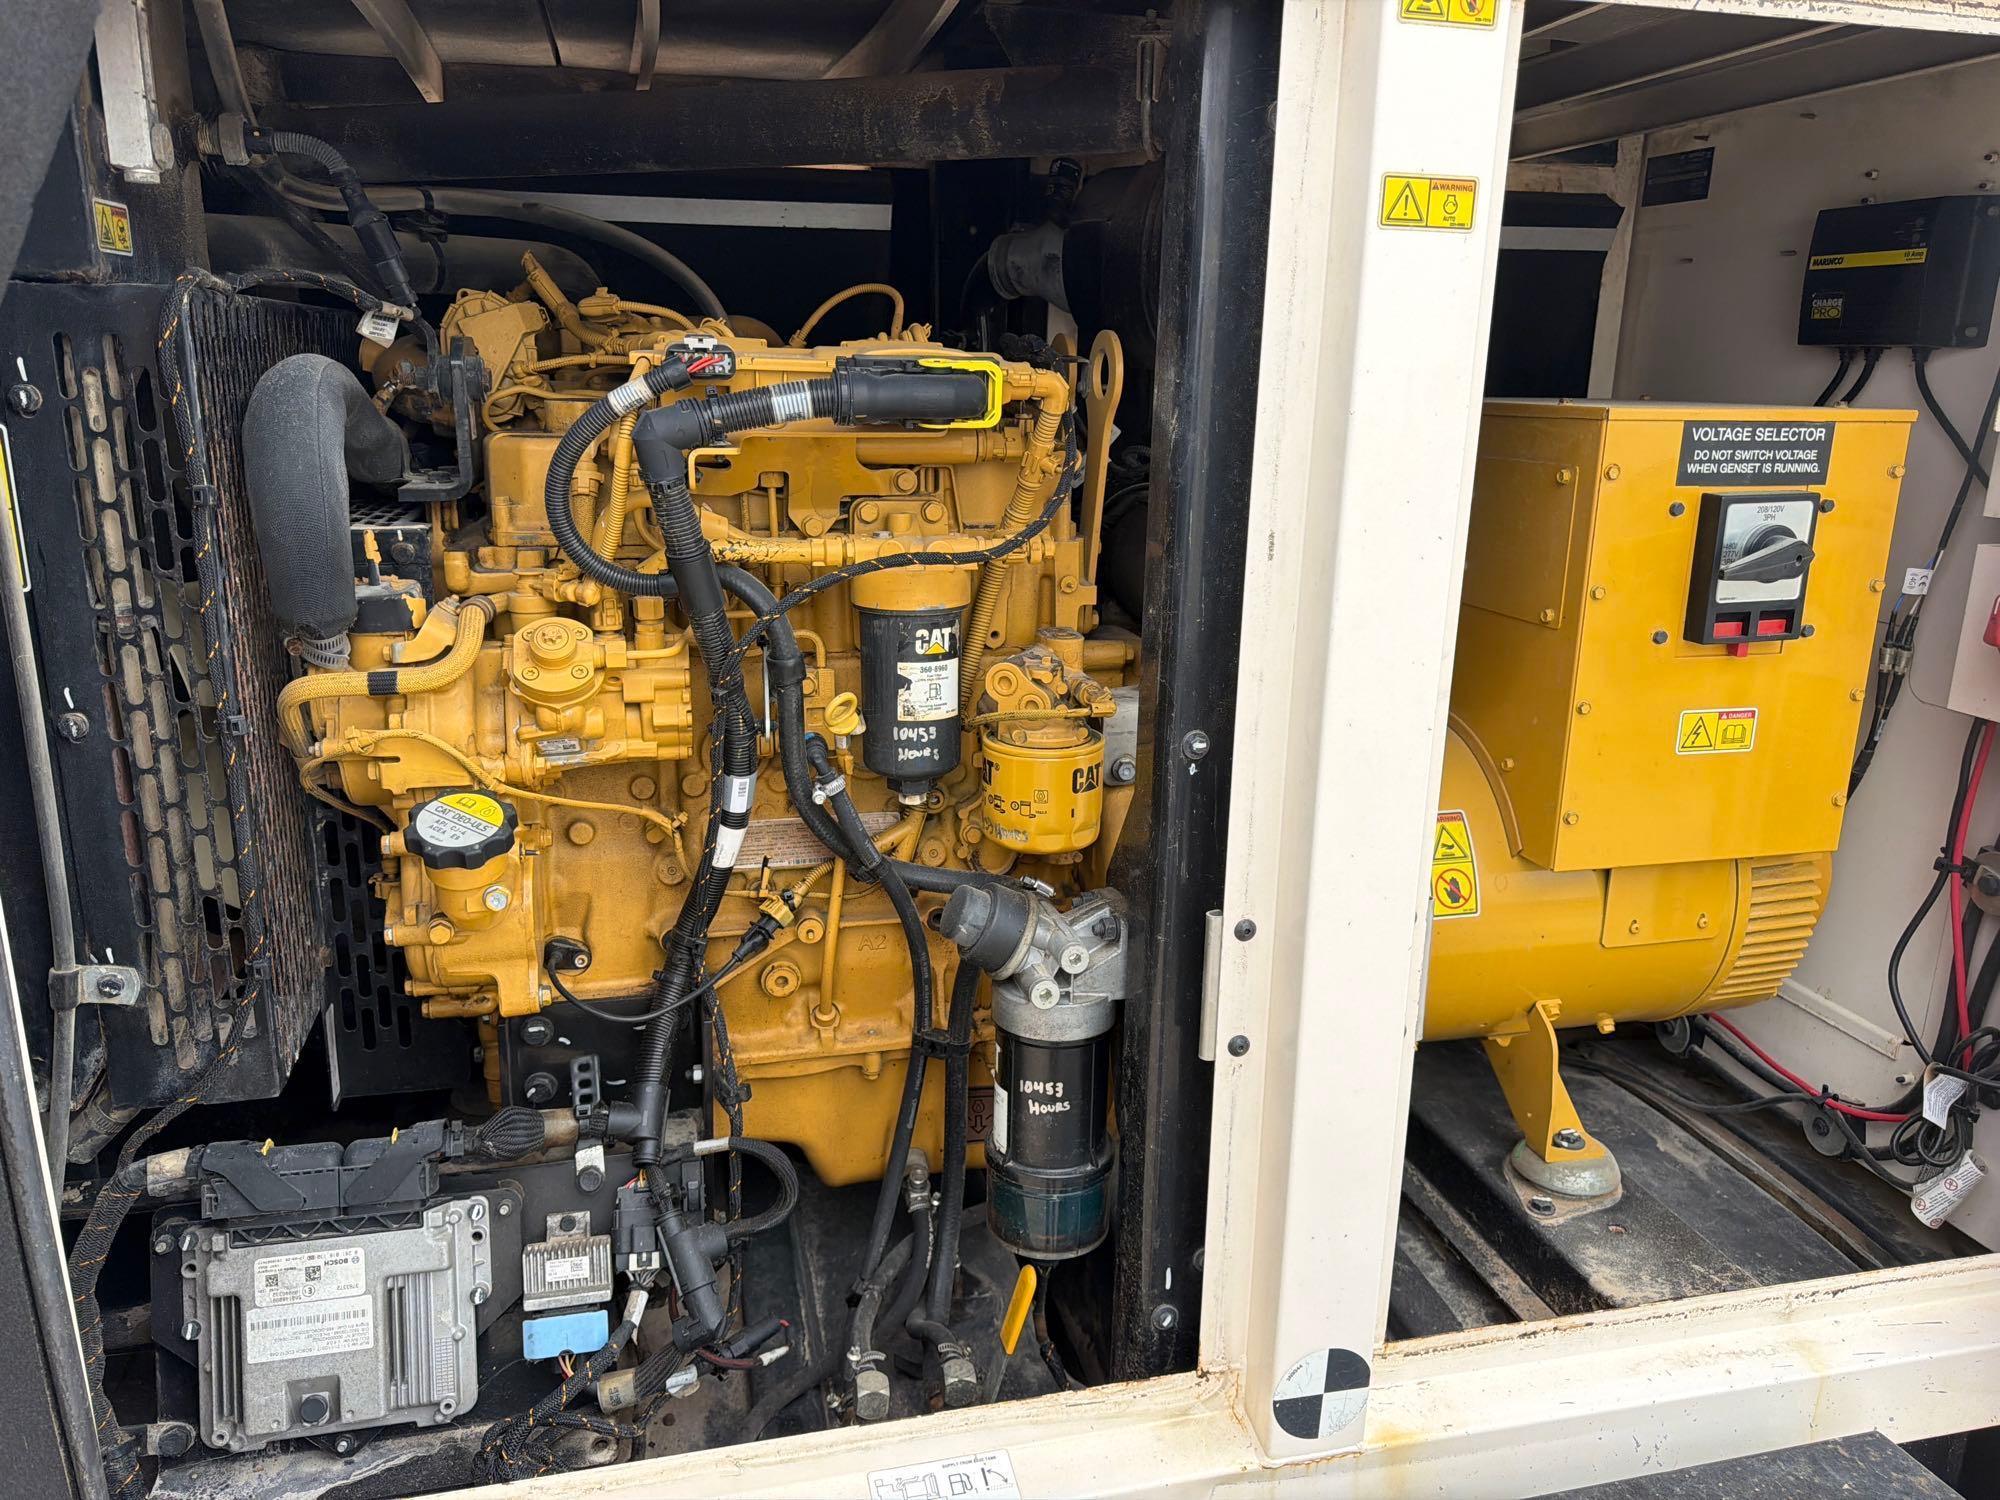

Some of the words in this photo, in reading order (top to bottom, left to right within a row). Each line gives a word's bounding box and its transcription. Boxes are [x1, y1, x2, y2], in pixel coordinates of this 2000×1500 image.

[1440, 184, 1473, 192] WARNING
[1812, 256, 1844, 266] MARINCO
[1812, 298, 1843, 307] CHARGE
[1812, 307, 1840, 318] PRO
[1692, 428, 1752, 442] VOLTAGE
[1755, 428, 1825, 442] SELECTOR
[1694, 450, 1709, 460] DO
[1712, 450, 1732, 460] NOT
[1734, 450, 1773, 460] SWITCH
[1775, 450, 1818, 460] VOLTAGE
[1687, 463, 1717, 473] WHEN
[1720, 463, 1760, 473] GENSET
[1762, 463, 1772, 473] IS
[1774, 463, 1820, 473] RUNNING.
[1757, 505, 1785, 513] 208/120V
[916, 627, 952, 655] CAT
[858, 934, 886, 951] A2
[1020, 1080, 1063, 1098] 10453
